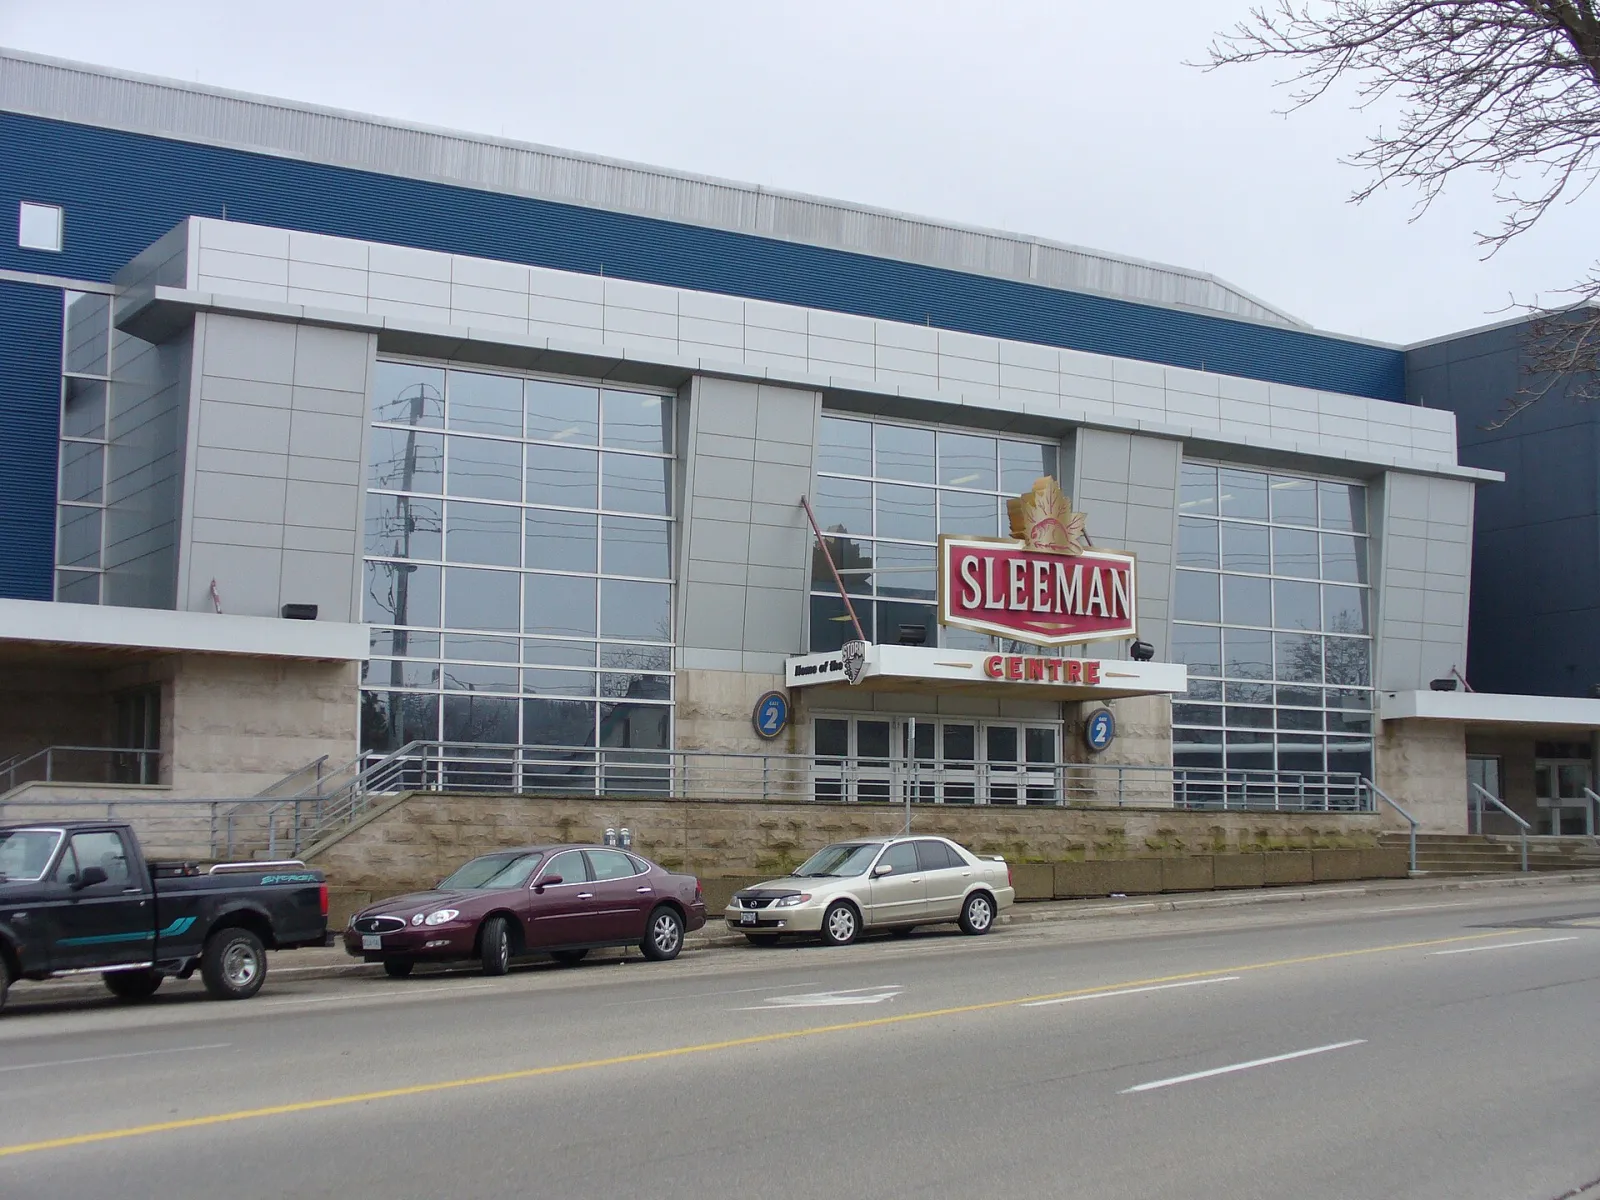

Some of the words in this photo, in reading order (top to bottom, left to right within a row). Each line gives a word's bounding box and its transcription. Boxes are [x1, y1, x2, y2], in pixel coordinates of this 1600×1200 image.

[961, 555, 1130, 619] SLEEMAN
[842, 642, 865, 659] STORM
[795, 665, 817, 676] Home
[819, 661, 828, 673] of
[830, 660, 843, 671] the
[985, 655, 1100, 684] CENTRE
[764, 707, 778, 728] 2
[1095, 722, 1106, 742] 2
